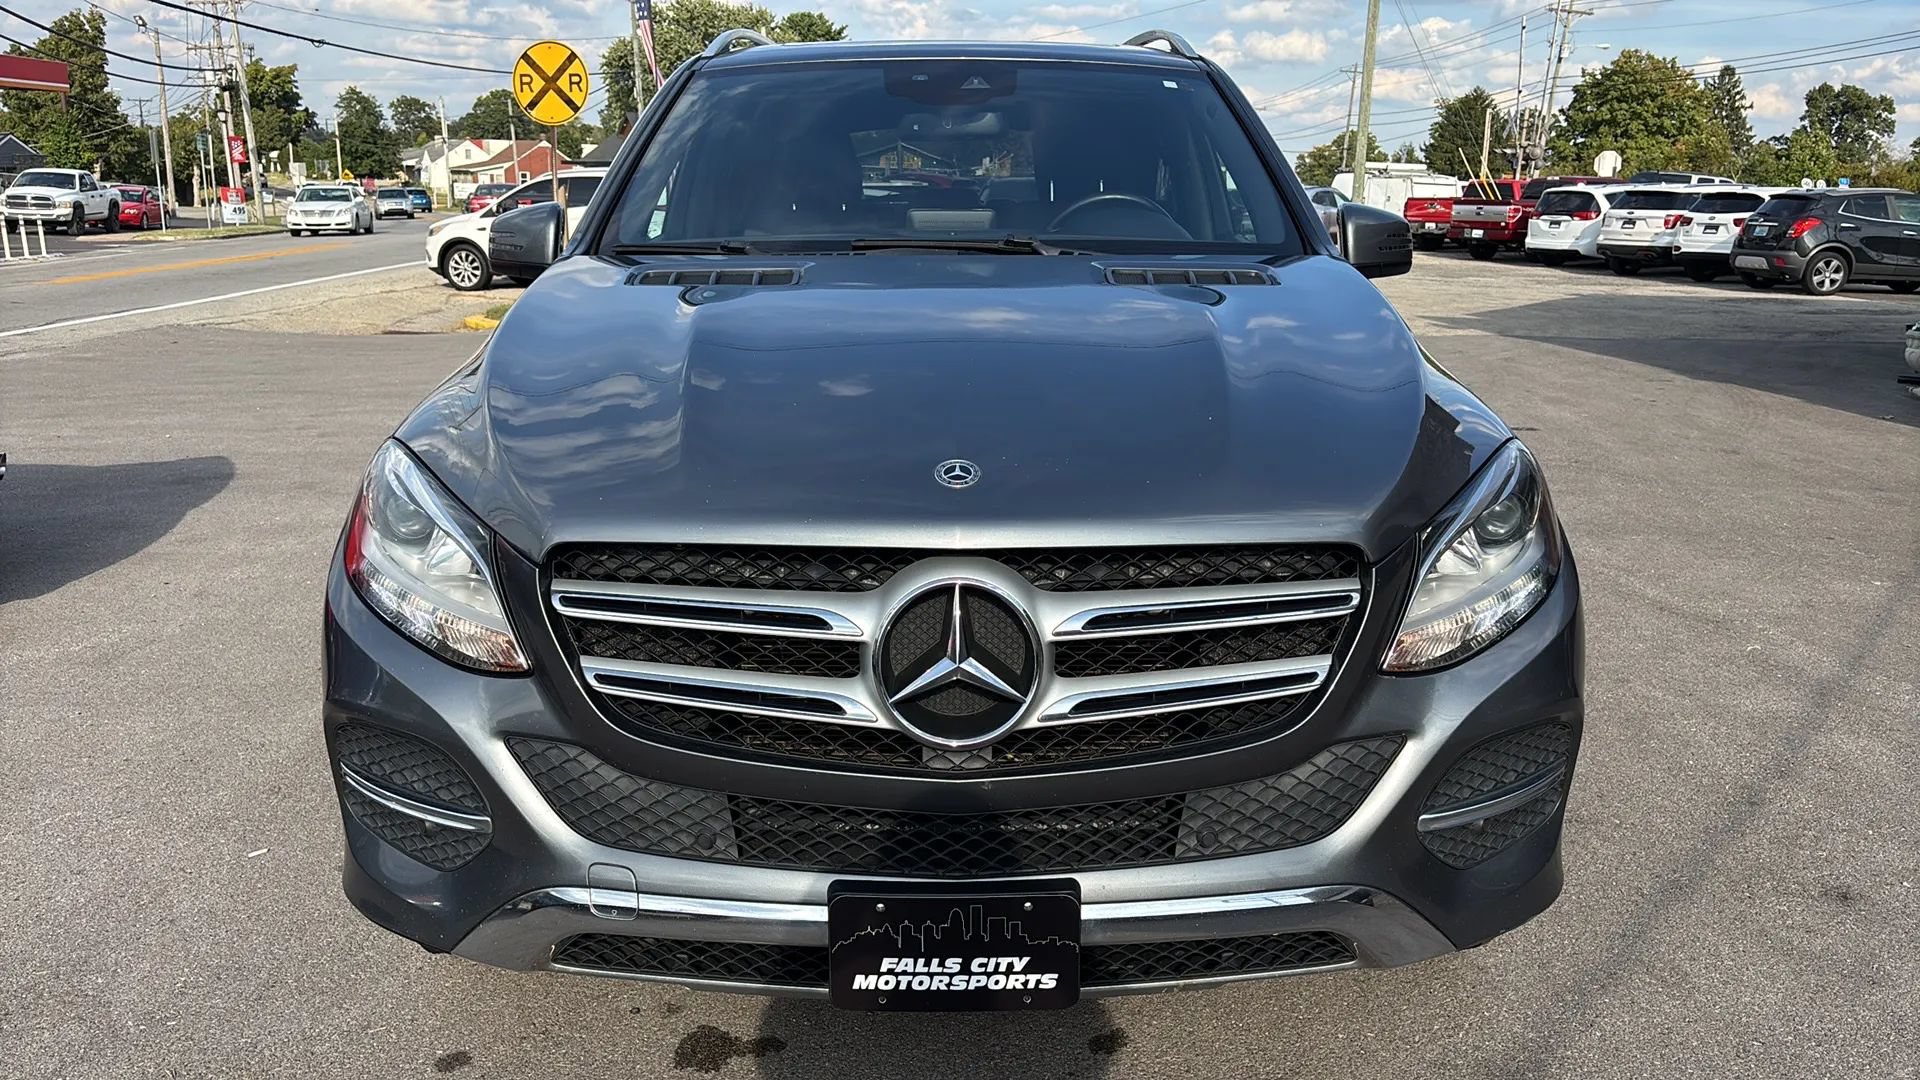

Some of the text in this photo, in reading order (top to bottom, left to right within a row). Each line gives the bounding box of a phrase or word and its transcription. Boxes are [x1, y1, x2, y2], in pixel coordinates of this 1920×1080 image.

[519, 73, 583, 93] R R
[879, 956, 1031, 973] FALLS CITY
[852, 973, 1059, 991] MOTORSPORTS
